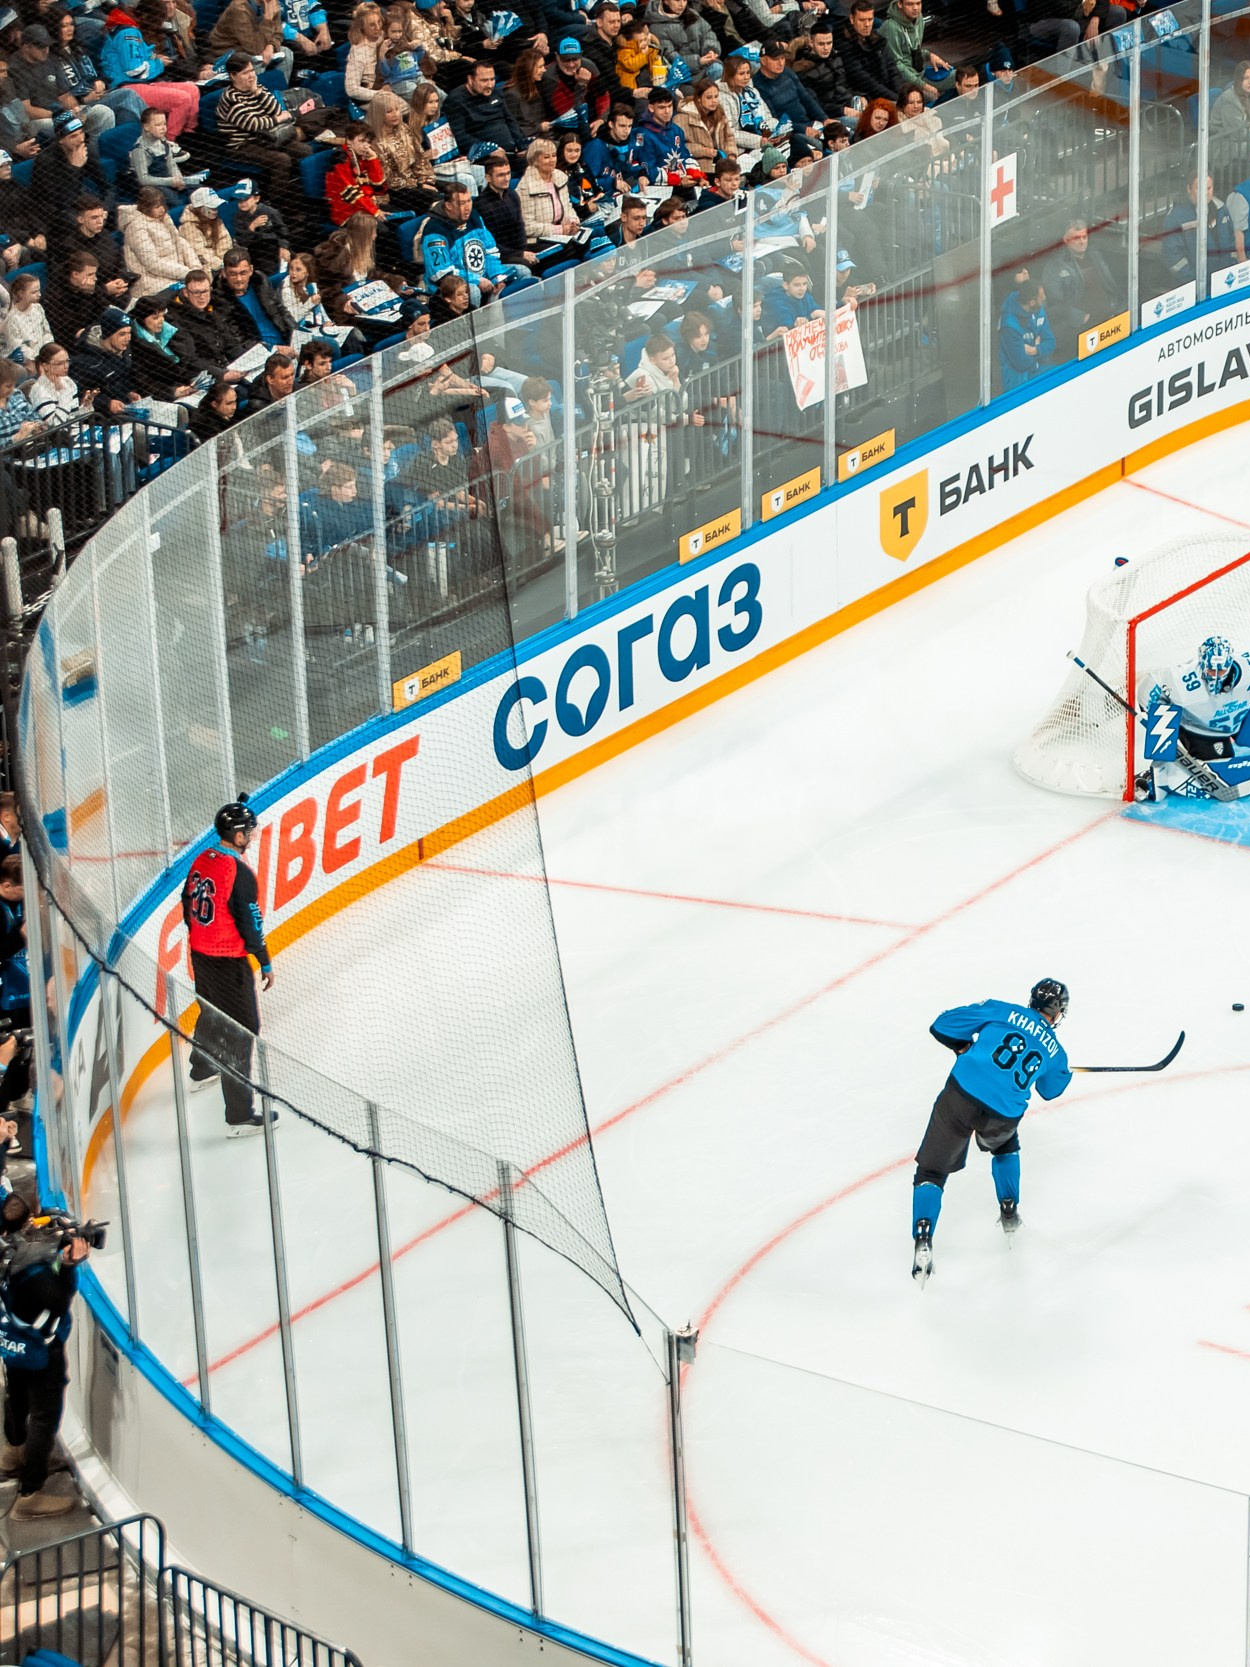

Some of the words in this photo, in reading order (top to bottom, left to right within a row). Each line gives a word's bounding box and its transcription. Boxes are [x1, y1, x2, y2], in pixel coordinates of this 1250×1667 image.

[1100, 324, 1121, 342] БАНК
[861, 442, 885, 463] БАНК
[939, 433, 1035, 517] БАНК
[786, 481, 811, 502] БАНК
[705, 522, 731, 544] БАНК
[421, 666, 450, 689] БАНК
[1181, 671, 1202, 692] 59
[1008, 1011, 1059, 1058] KHAFIZOV
[991, 1031, 1043, 1091] 89
